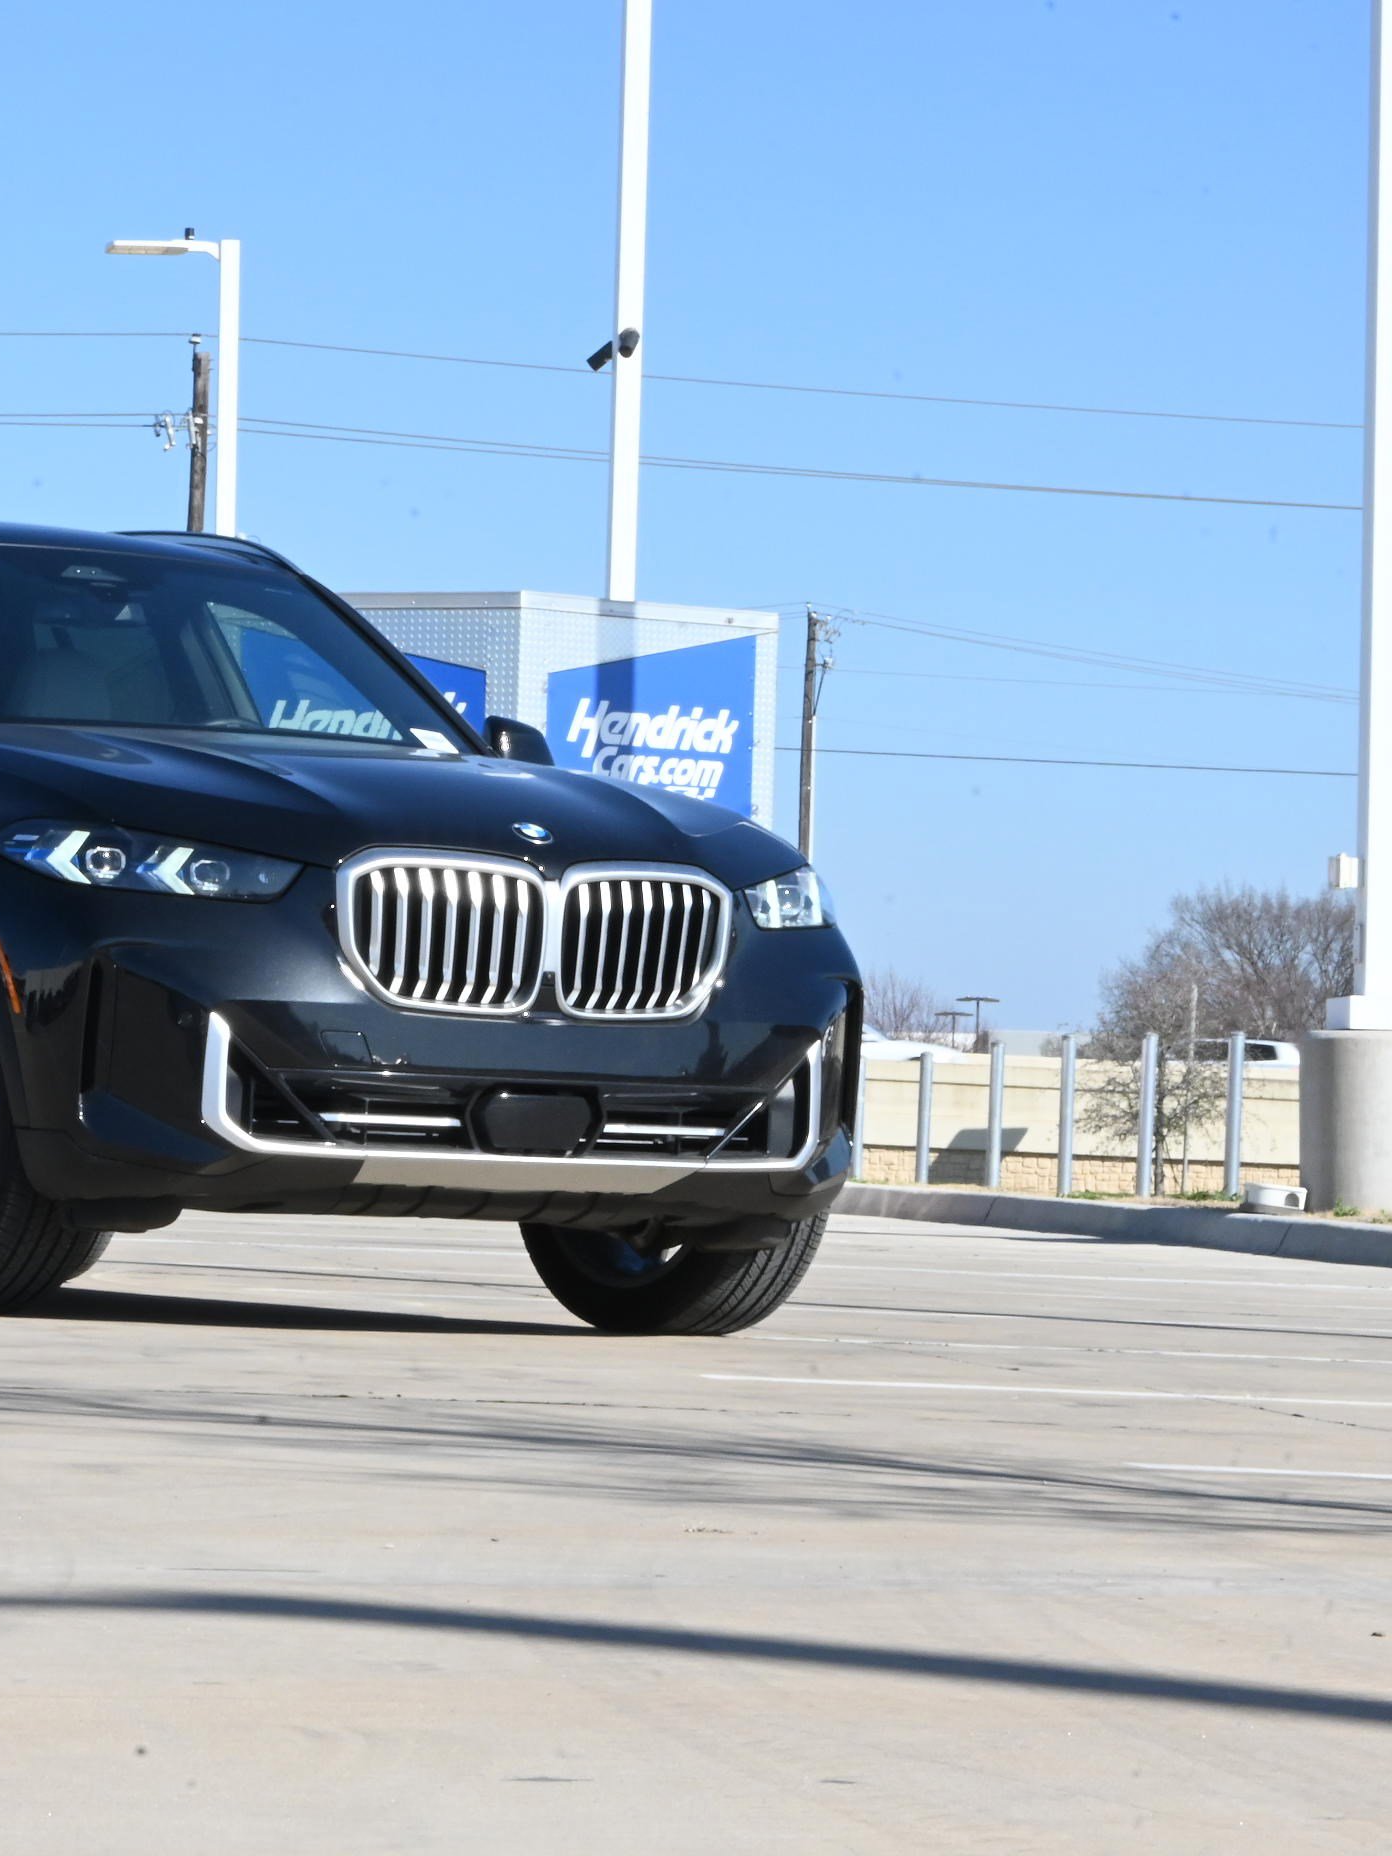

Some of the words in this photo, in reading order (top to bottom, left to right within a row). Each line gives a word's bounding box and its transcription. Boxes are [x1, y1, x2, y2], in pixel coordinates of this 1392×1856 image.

[269, 692, 467, 741] Hend
[566, 697, 739, 758] Hendrick
[592, 746, 724, 787] Cars.com
